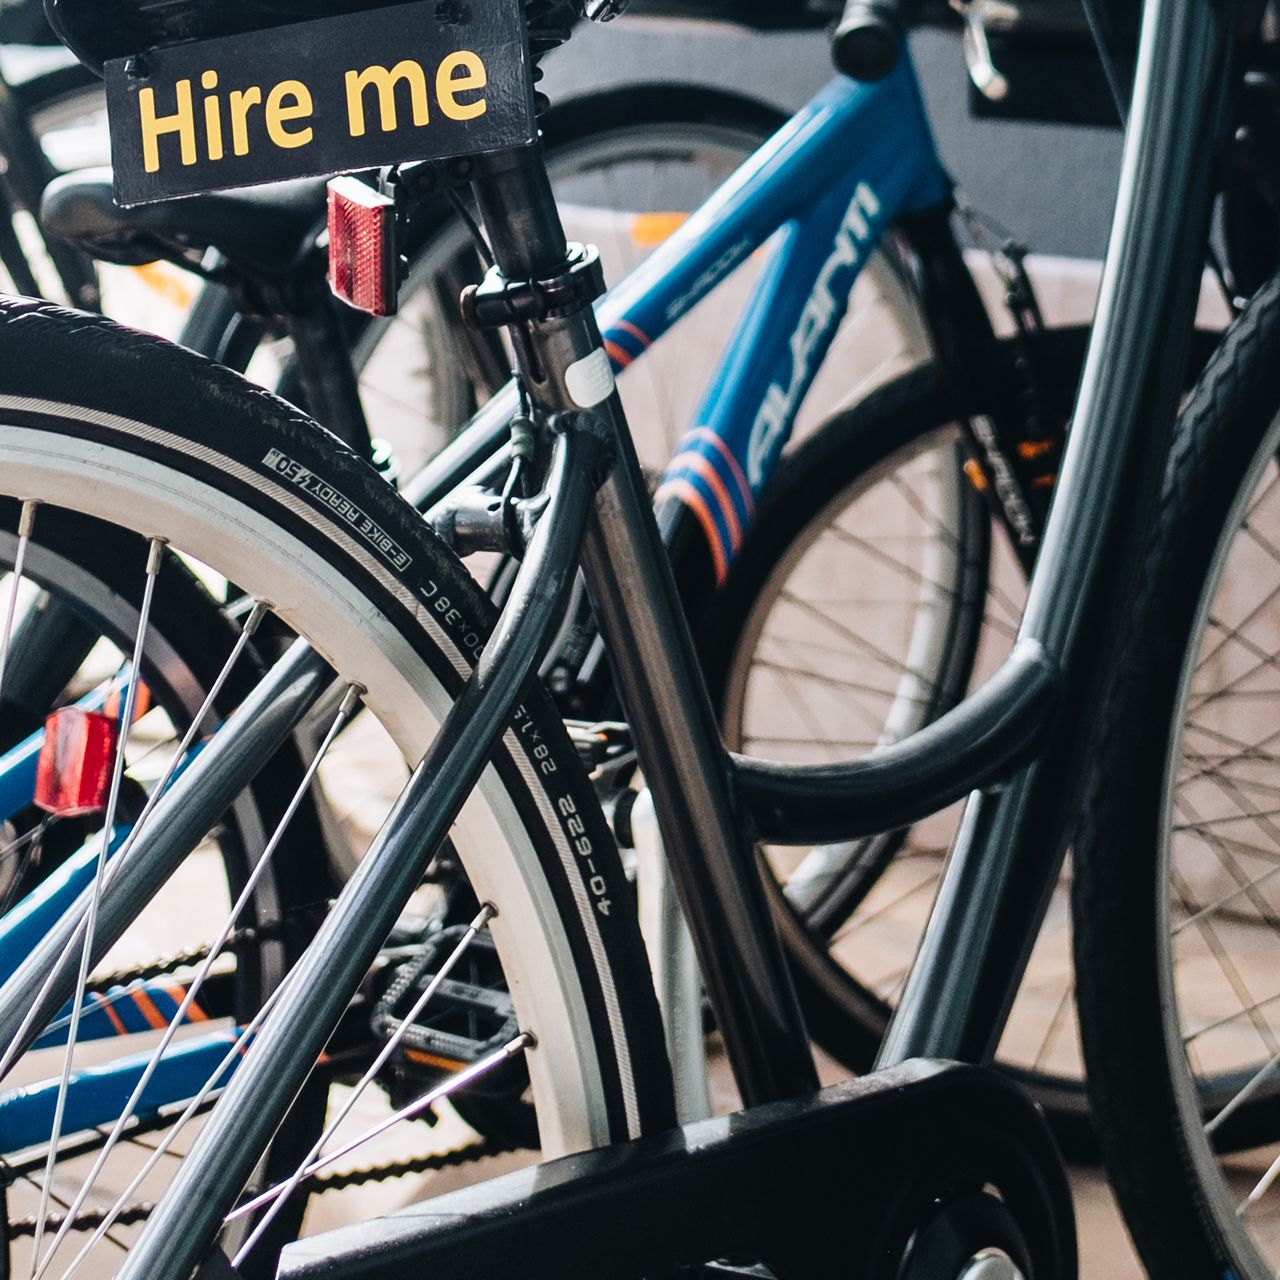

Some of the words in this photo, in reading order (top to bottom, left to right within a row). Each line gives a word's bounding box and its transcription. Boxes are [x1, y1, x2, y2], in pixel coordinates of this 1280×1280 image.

[137, 70, 313, 174] Hire
[345, 49, 488, 138] me
[311, 481, 360, 523] READY
[360, 519, 407, 566] E-BIKE
[559, 793, 612, 916] 40-622
